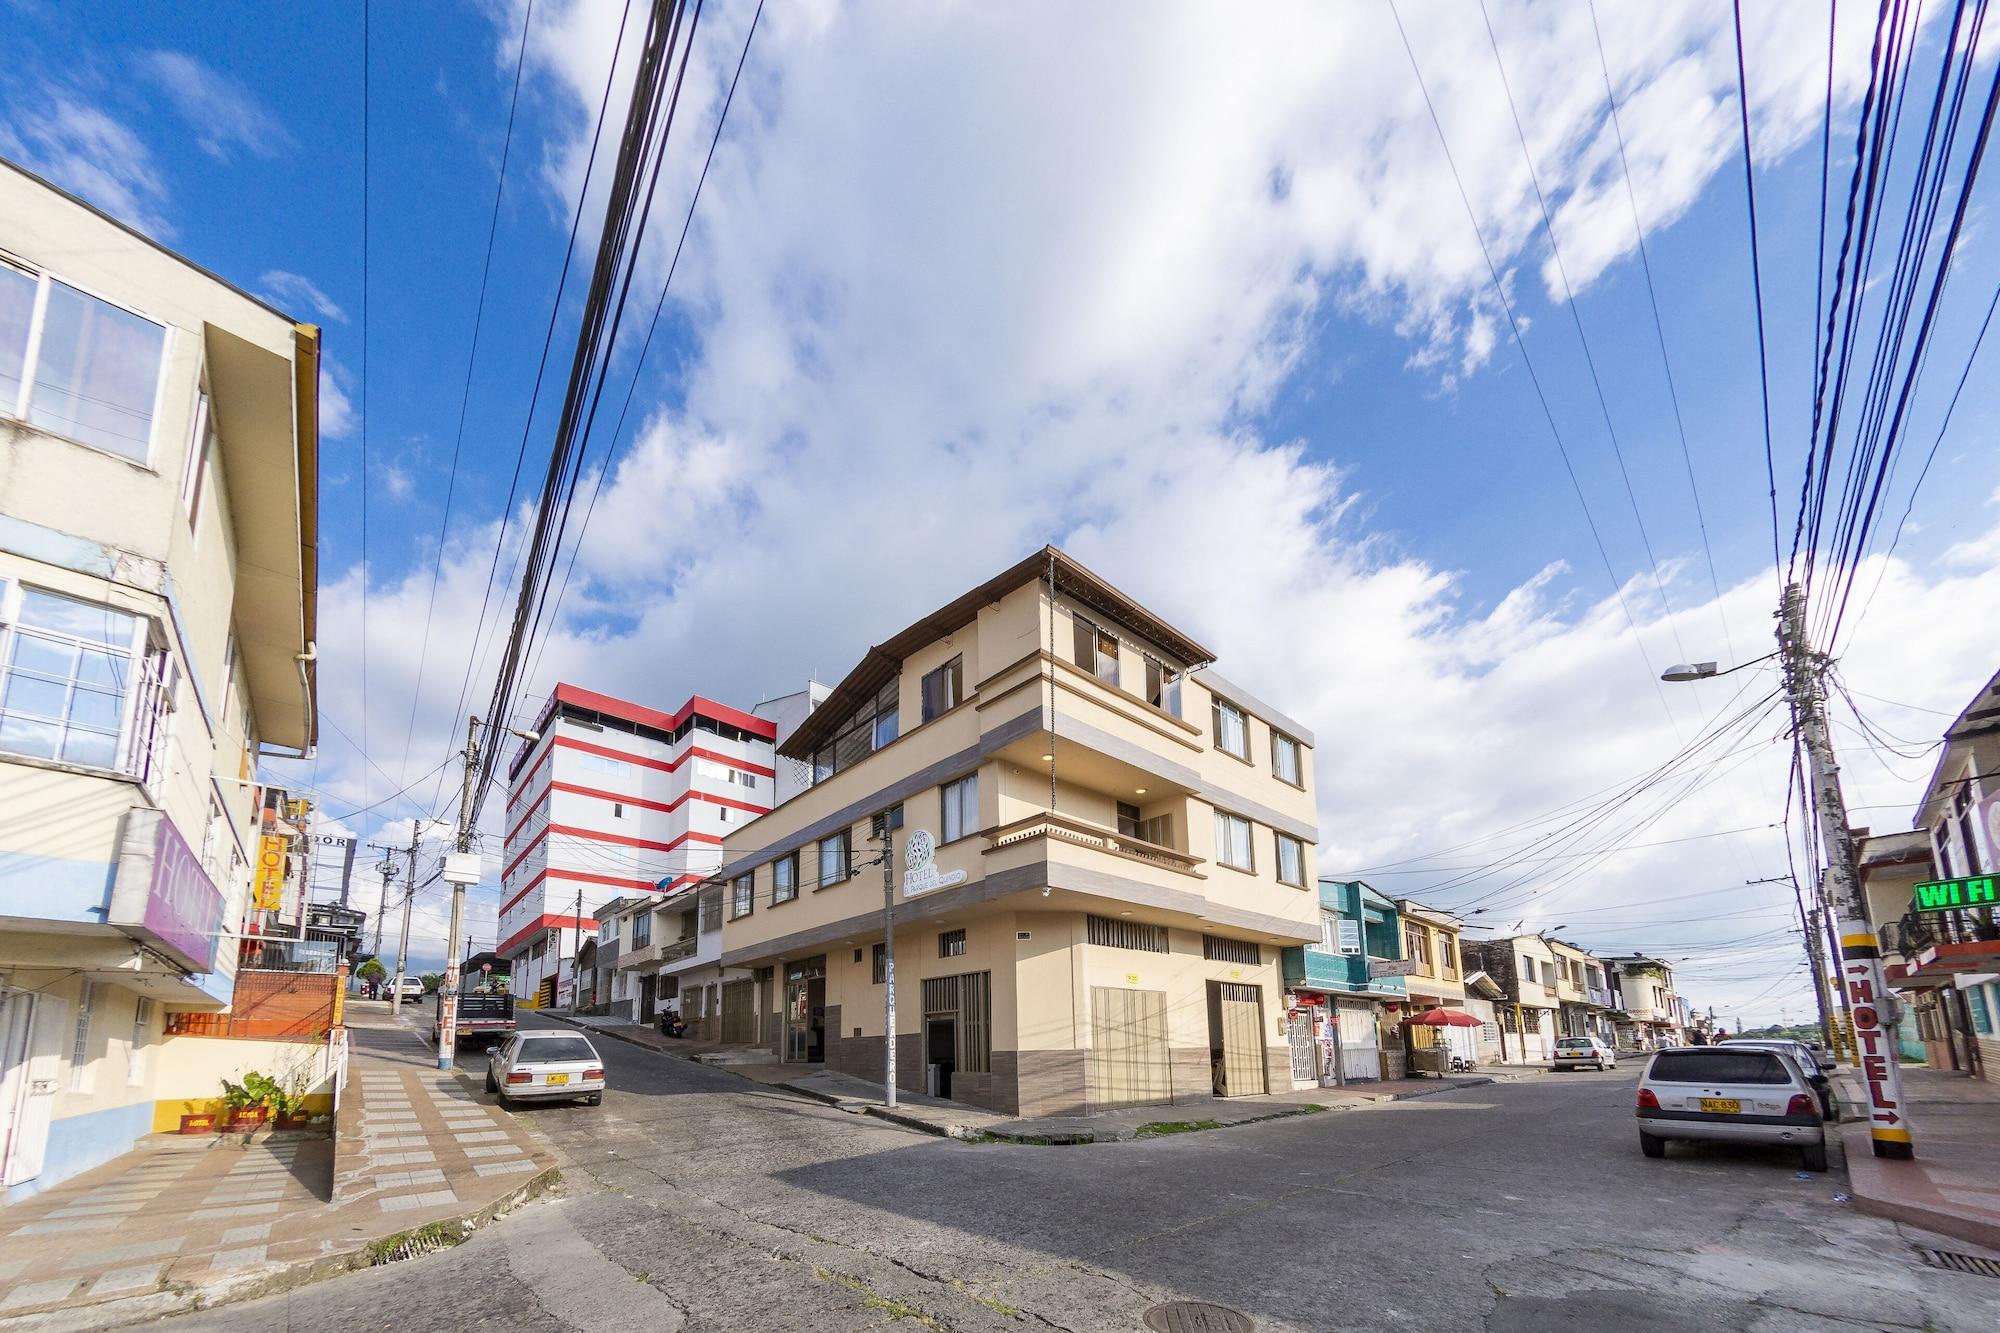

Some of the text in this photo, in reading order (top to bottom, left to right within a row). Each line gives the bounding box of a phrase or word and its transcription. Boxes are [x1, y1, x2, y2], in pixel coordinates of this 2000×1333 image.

[153, 827, 214, 939] HOTEL
[260, 837, 283, 907] HOTEL
[905, 868, 933, 886] HOTEL
[1919, 879, 1994, 907] WI FI
[888, 962, 896, 1083] PARQUEADERO
[1849, 980, 1896, 1109] HOTEL
